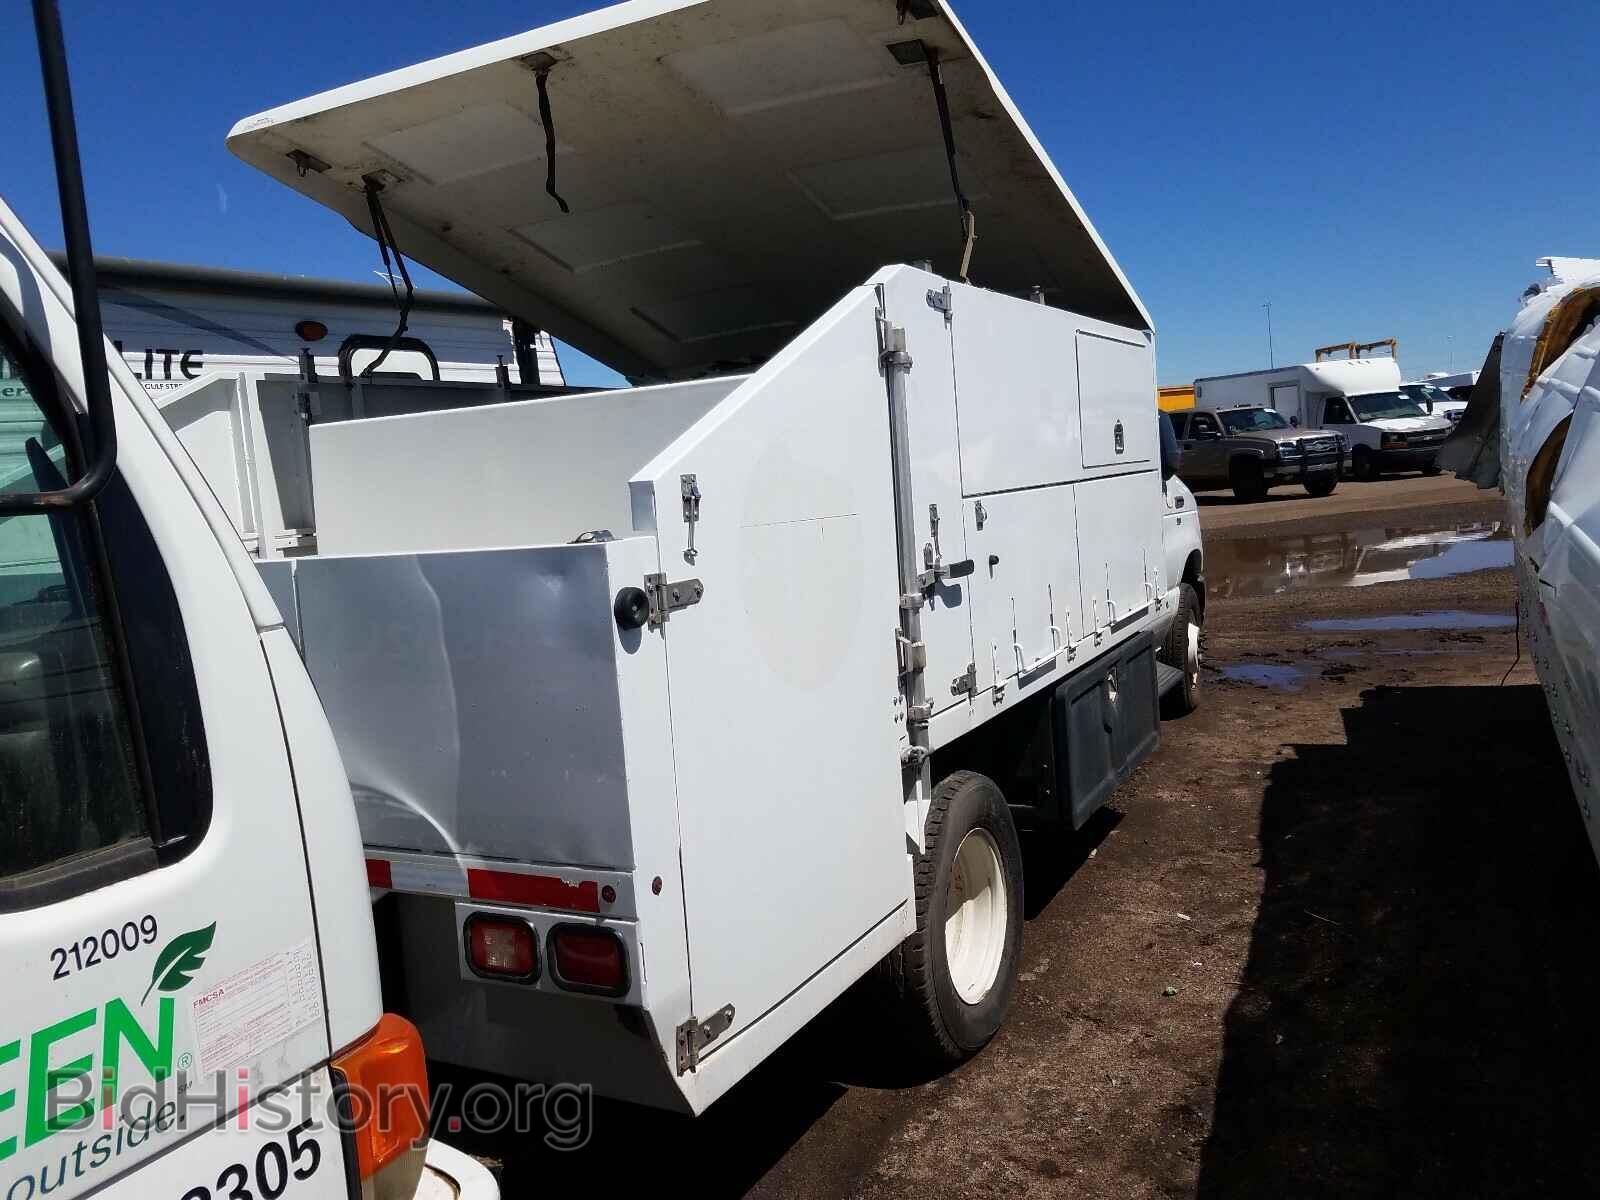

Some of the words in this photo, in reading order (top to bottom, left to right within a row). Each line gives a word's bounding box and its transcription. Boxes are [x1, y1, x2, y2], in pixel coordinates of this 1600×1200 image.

[50, 914, 158, 981] 212009
[193, 988, 225, 1009] FMCSA
[0, 997, 175, 1161] EN
[6, 1100, 185, 1200] outside.
[180, 1117, 322, 1200] 305
